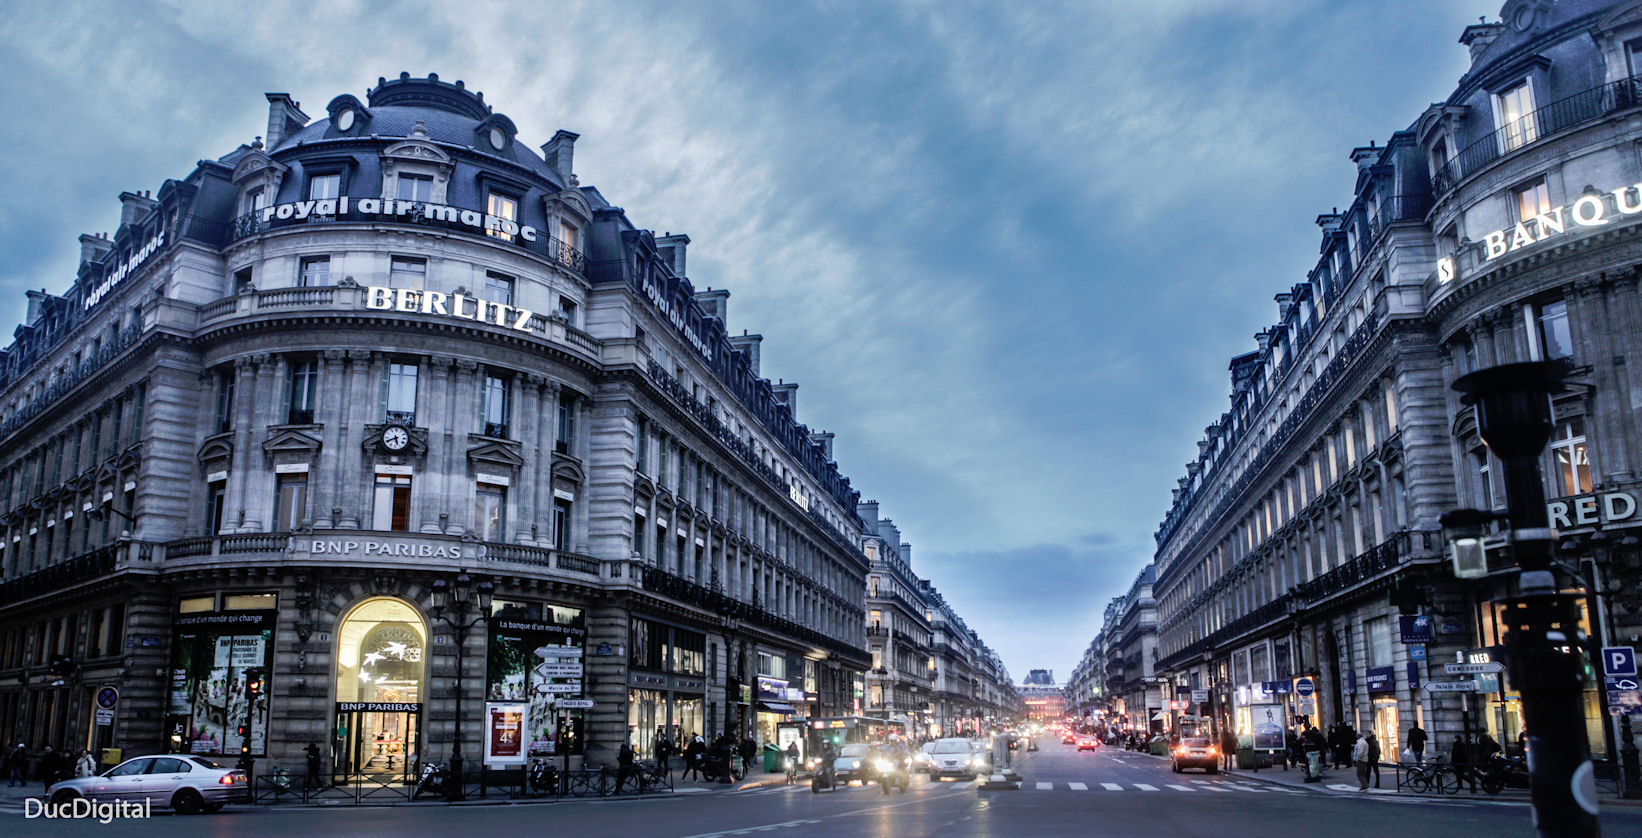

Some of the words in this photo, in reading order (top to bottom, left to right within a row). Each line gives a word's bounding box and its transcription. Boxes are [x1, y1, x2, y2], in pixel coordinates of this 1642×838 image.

[263, 196, 348, 222] royal
[357, 196, 411, 216] air
[424, 202, 537, 242] maroc
[85, 275, 111, 310] royal
[111, 259, 128, 287] air
[128, 230, 165, 273] maroc
[366, 286, 534, 332] BERLITZ
[642, 278, 670, 316] royal
[670, 308, 685, 332] air
[684, 323, 713, 362] maroc
[790, 484, 809, 513] BERLITZ
[1547, 492, 1636, 529] RED
[311, 540, 359, 554] BNP
[364, 541, 461, 559] PARIBAS
[208, 615, 228, 623] monde
[228, 615, 238, 624] qui
[238, 614, 263, 624] change
[508, 620, 531, 630] banque
[531, 623, 545, 631] d'un
[233, 639, 258, 648] PARIBAS
[1611, 652, 1627, 671] P
[340, 703, 366, 711] BNP
[367, 703, 418, 711] PARIBAS
